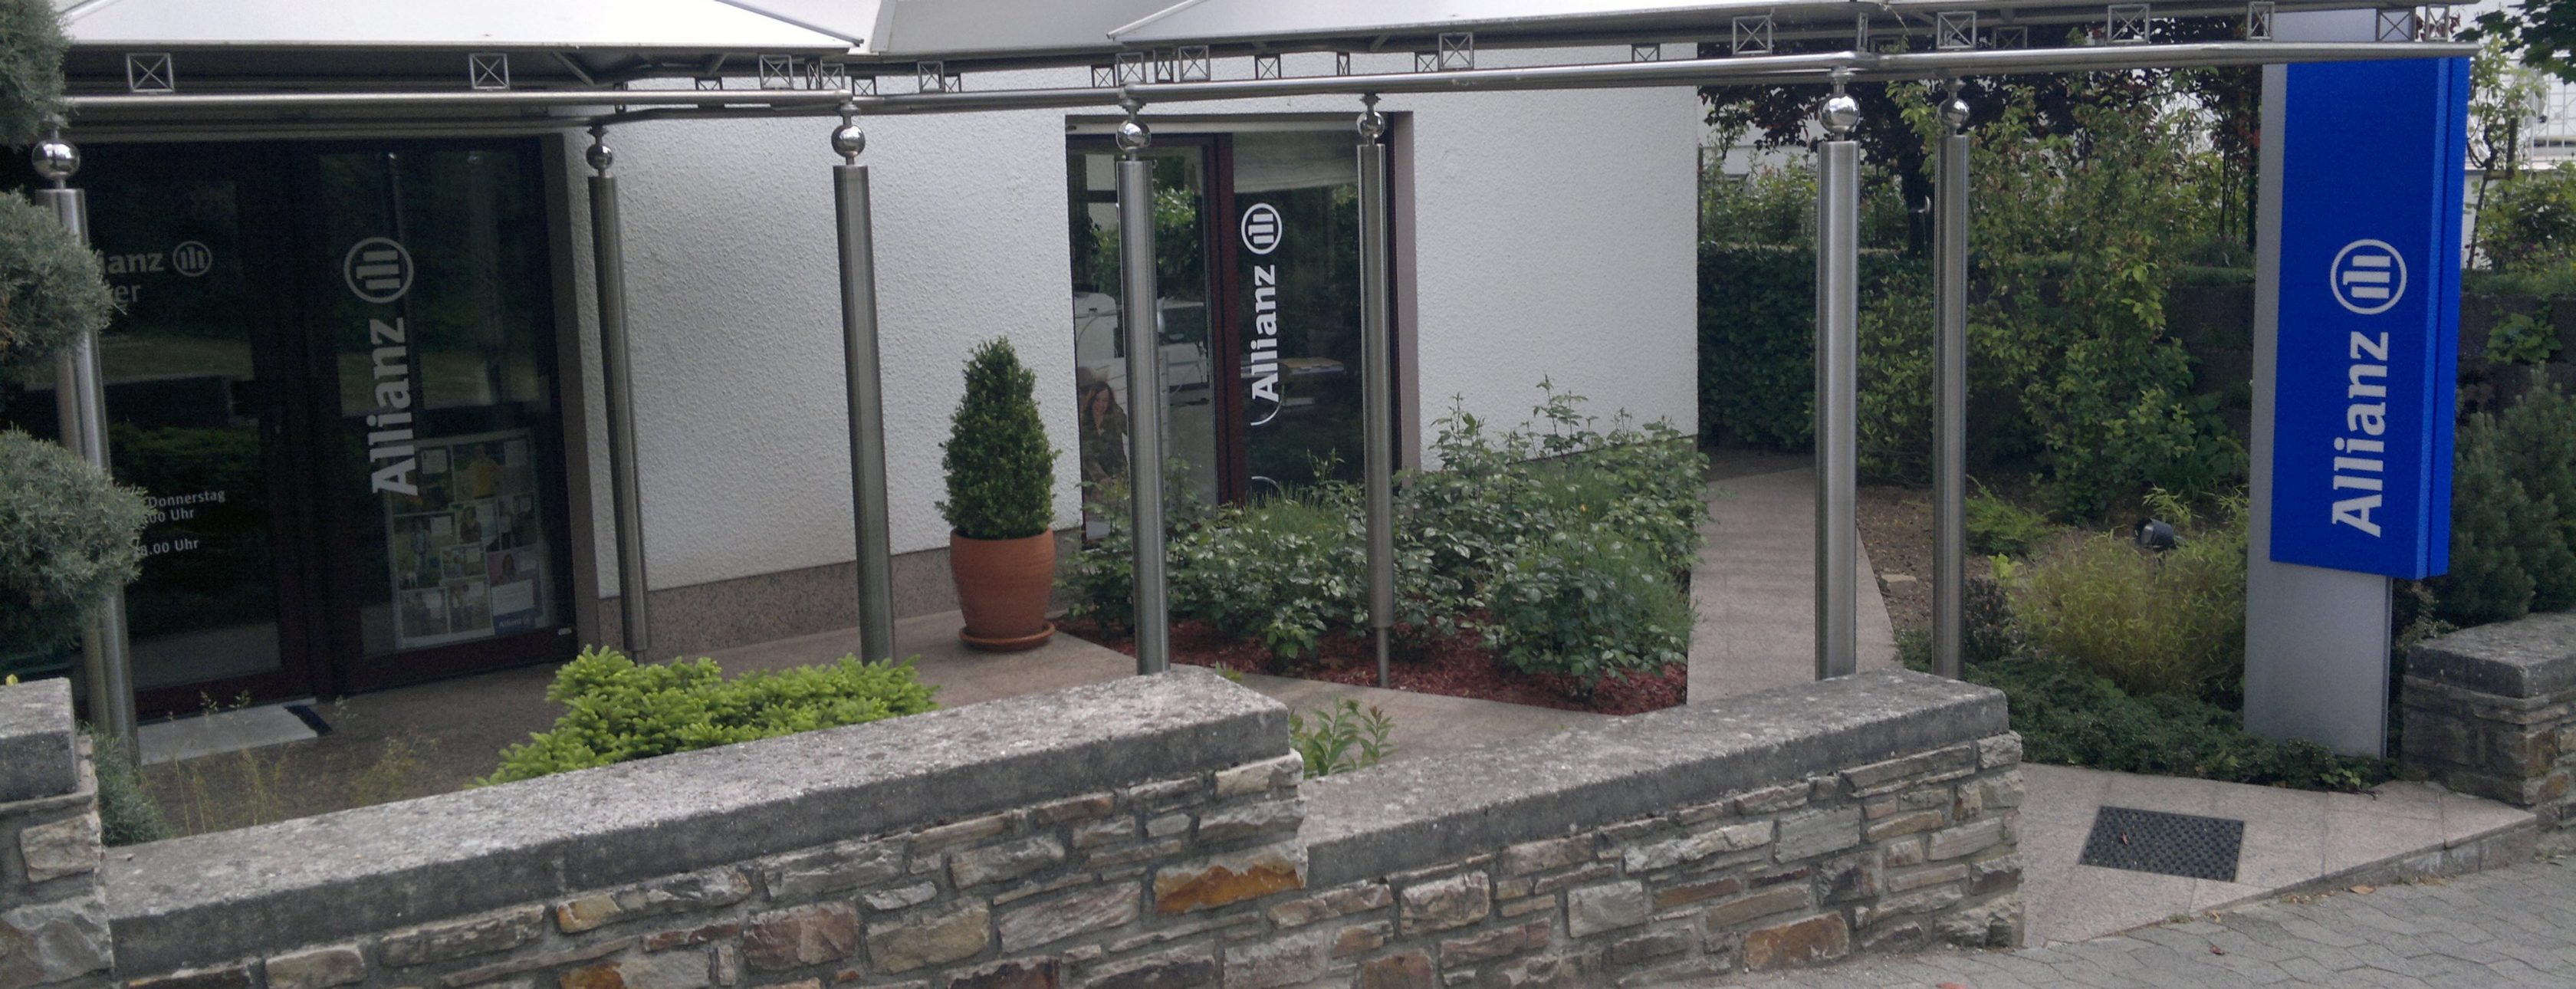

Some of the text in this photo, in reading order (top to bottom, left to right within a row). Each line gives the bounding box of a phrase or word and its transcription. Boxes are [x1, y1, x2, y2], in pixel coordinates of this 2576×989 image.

[96, 250, 165, 274] ianz
[1250, 264, 1279, 402] Allianz
[366, 317, 418, 496] Allianz
[2331, 331, 2389, 537] Allianz
[148, 490, 225, 508] Donnerstag
[171, 508, 194, 521] Uhr
[140, 538, 199, 556] 8.00 Uhr
